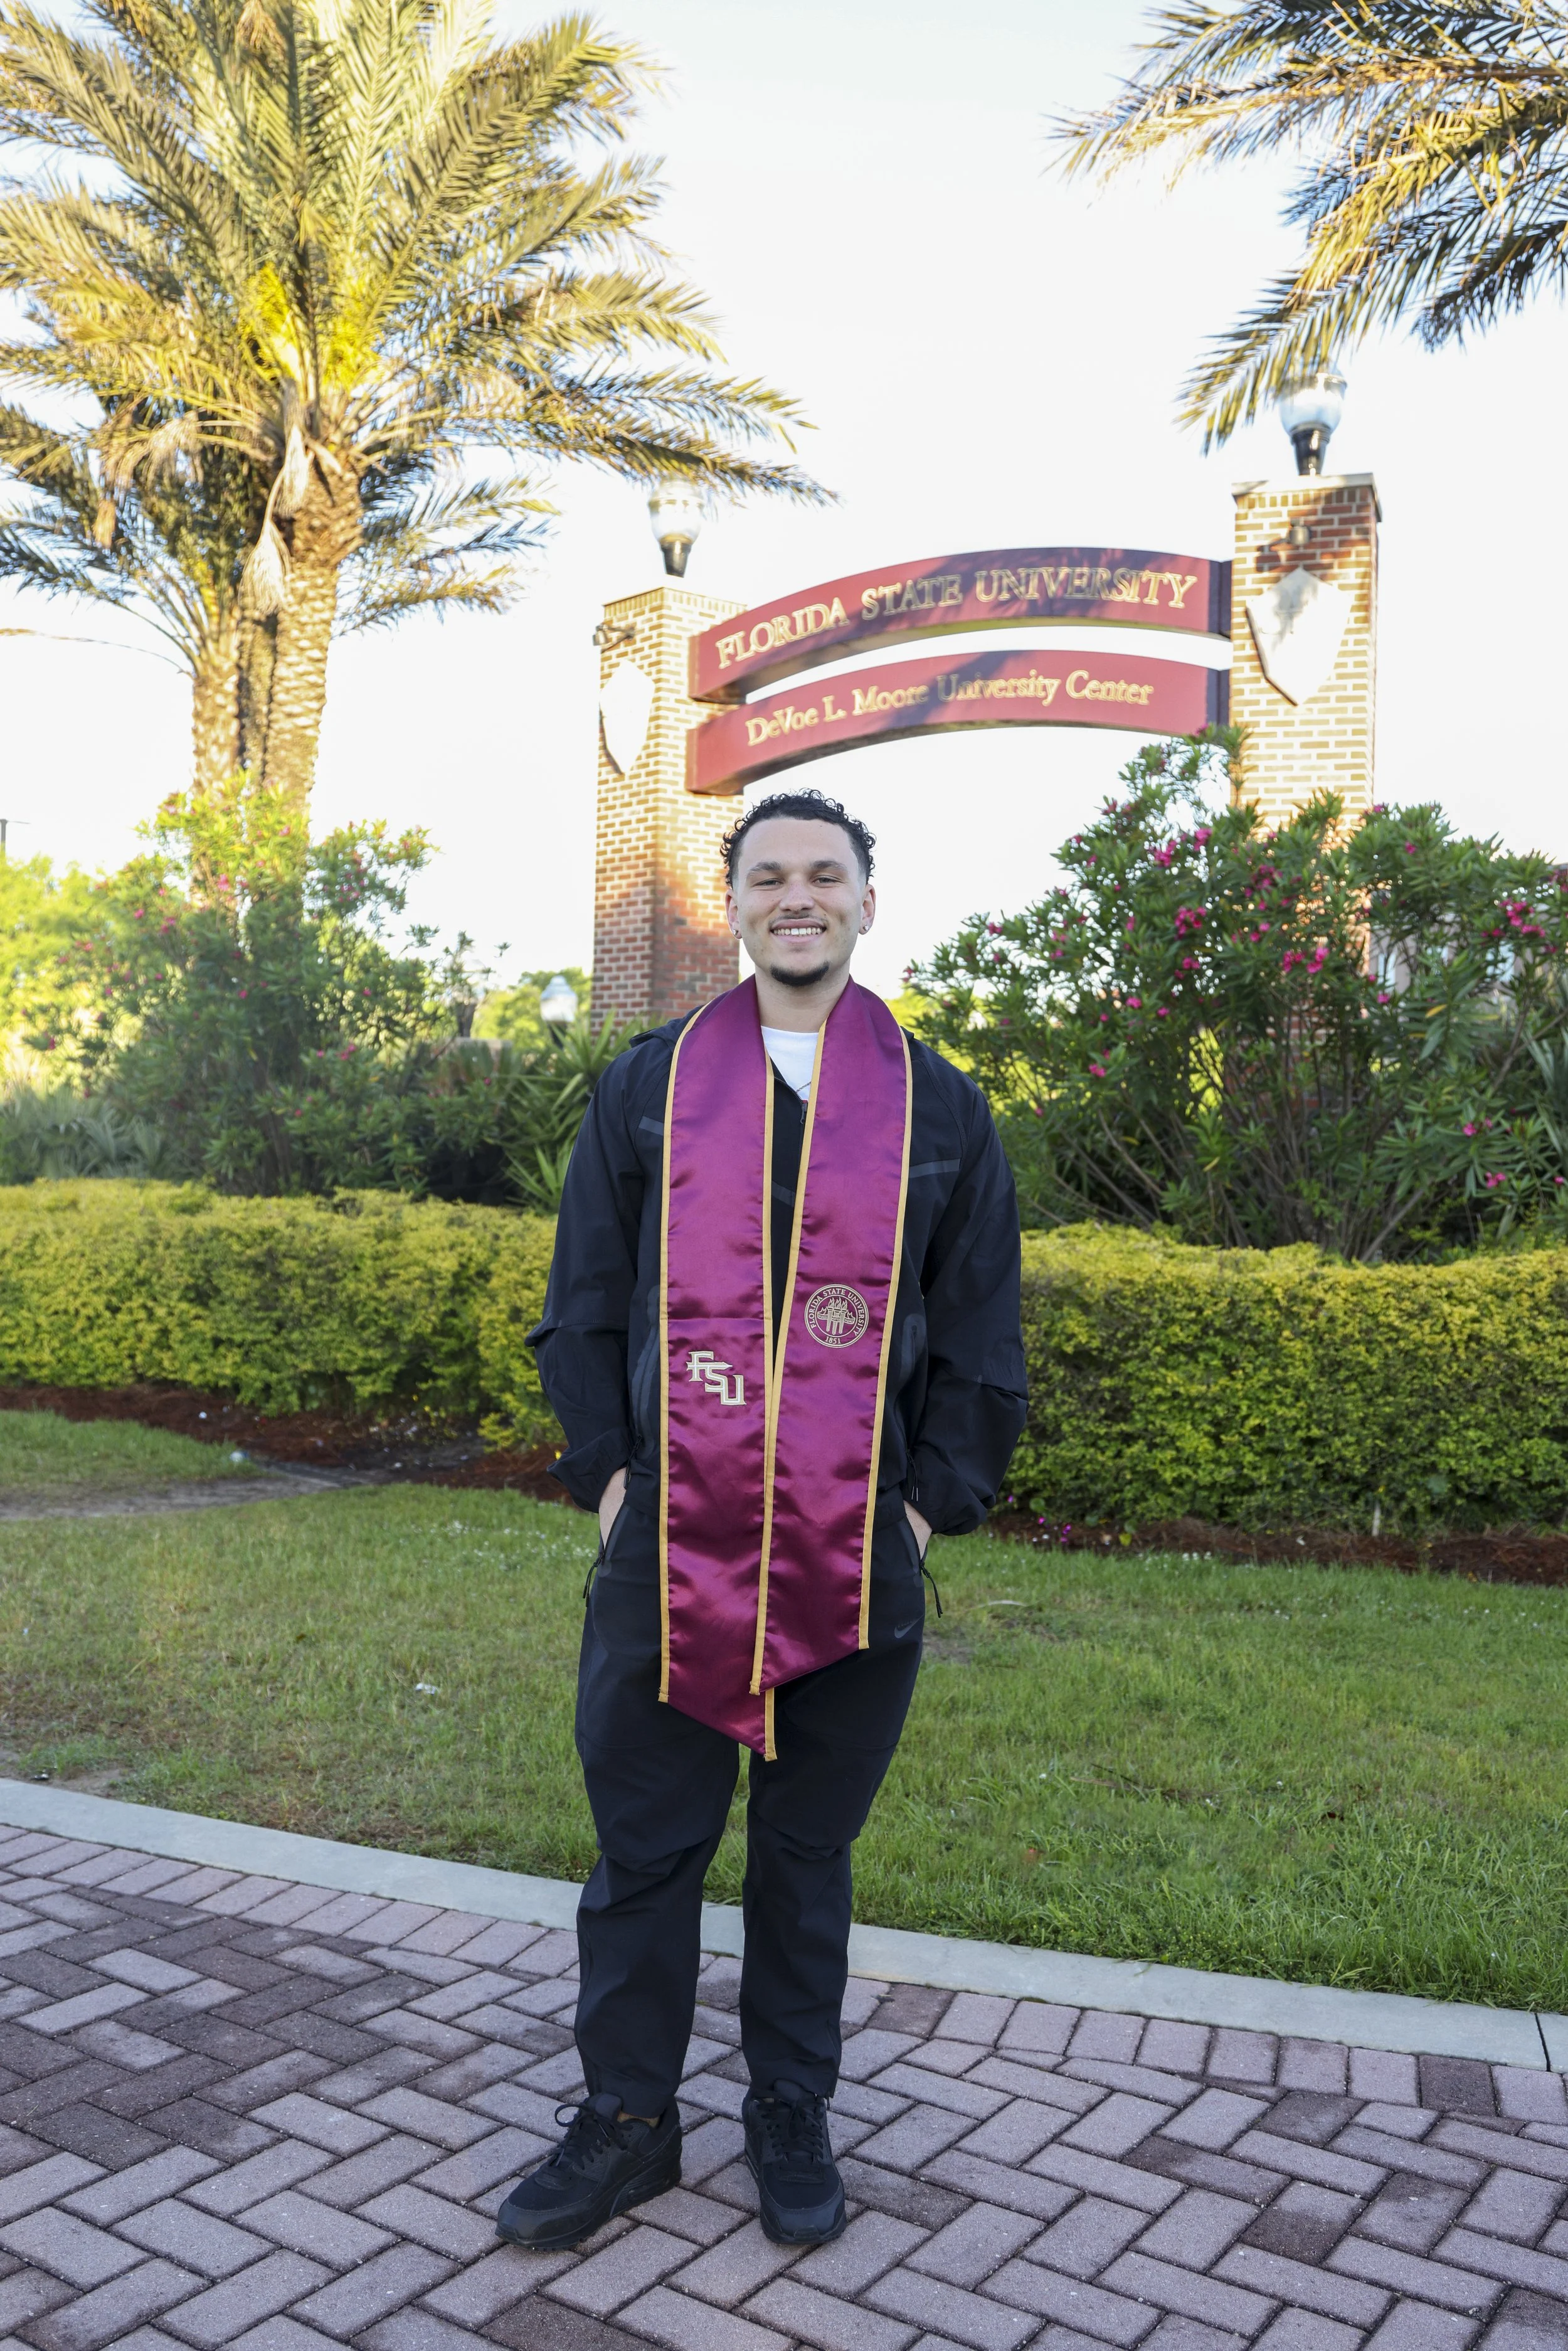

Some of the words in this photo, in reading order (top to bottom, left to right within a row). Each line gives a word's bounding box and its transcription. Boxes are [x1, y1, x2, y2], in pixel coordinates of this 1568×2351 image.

[715, 597, 850, 669] FLORIDA
[861, 574, 963, 620] STATE
[975, 566, 1198, 608] UNIVERSITY
[745, 706, 818, 746] DeVoe
[822, 695, 847, 722] L.
[851, 685, 929, 716] Moore
[936, 669, 1061, 706] University
[1066, 670, 1154, 705] Center
[808, 1296, 823, 1329] FLORIDA
[823, 1288, 846, 1297] STATE
[847, 1292, 865, 1336] UNIVERSITY
[825, 1336, 841, 1344] 1851
[686, 1351, 747, 1405] FSU
